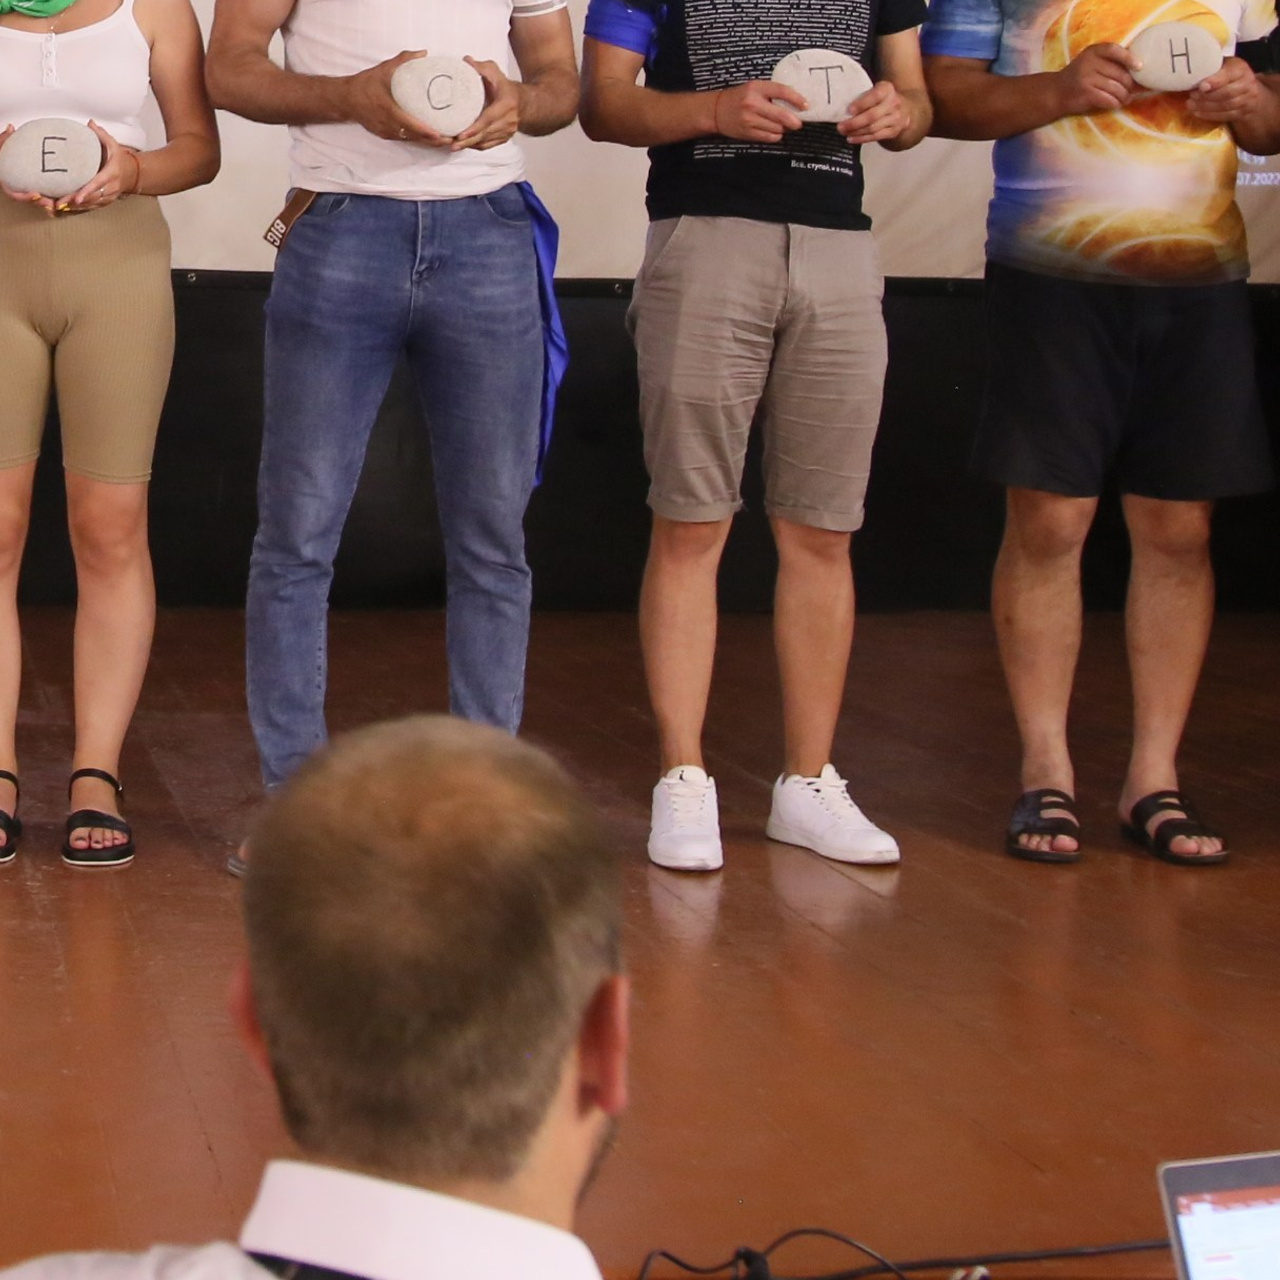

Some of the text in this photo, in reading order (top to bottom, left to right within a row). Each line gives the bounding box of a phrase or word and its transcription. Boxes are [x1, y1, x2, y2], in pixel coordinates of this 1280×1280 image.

[1169, 37, 1192, 75] Н
[427, 73, 453, 111] С
[809, 64, 845, 105] Т
[42, 136, 69, 173] Е
[266, 218, 287, 246] BIG
